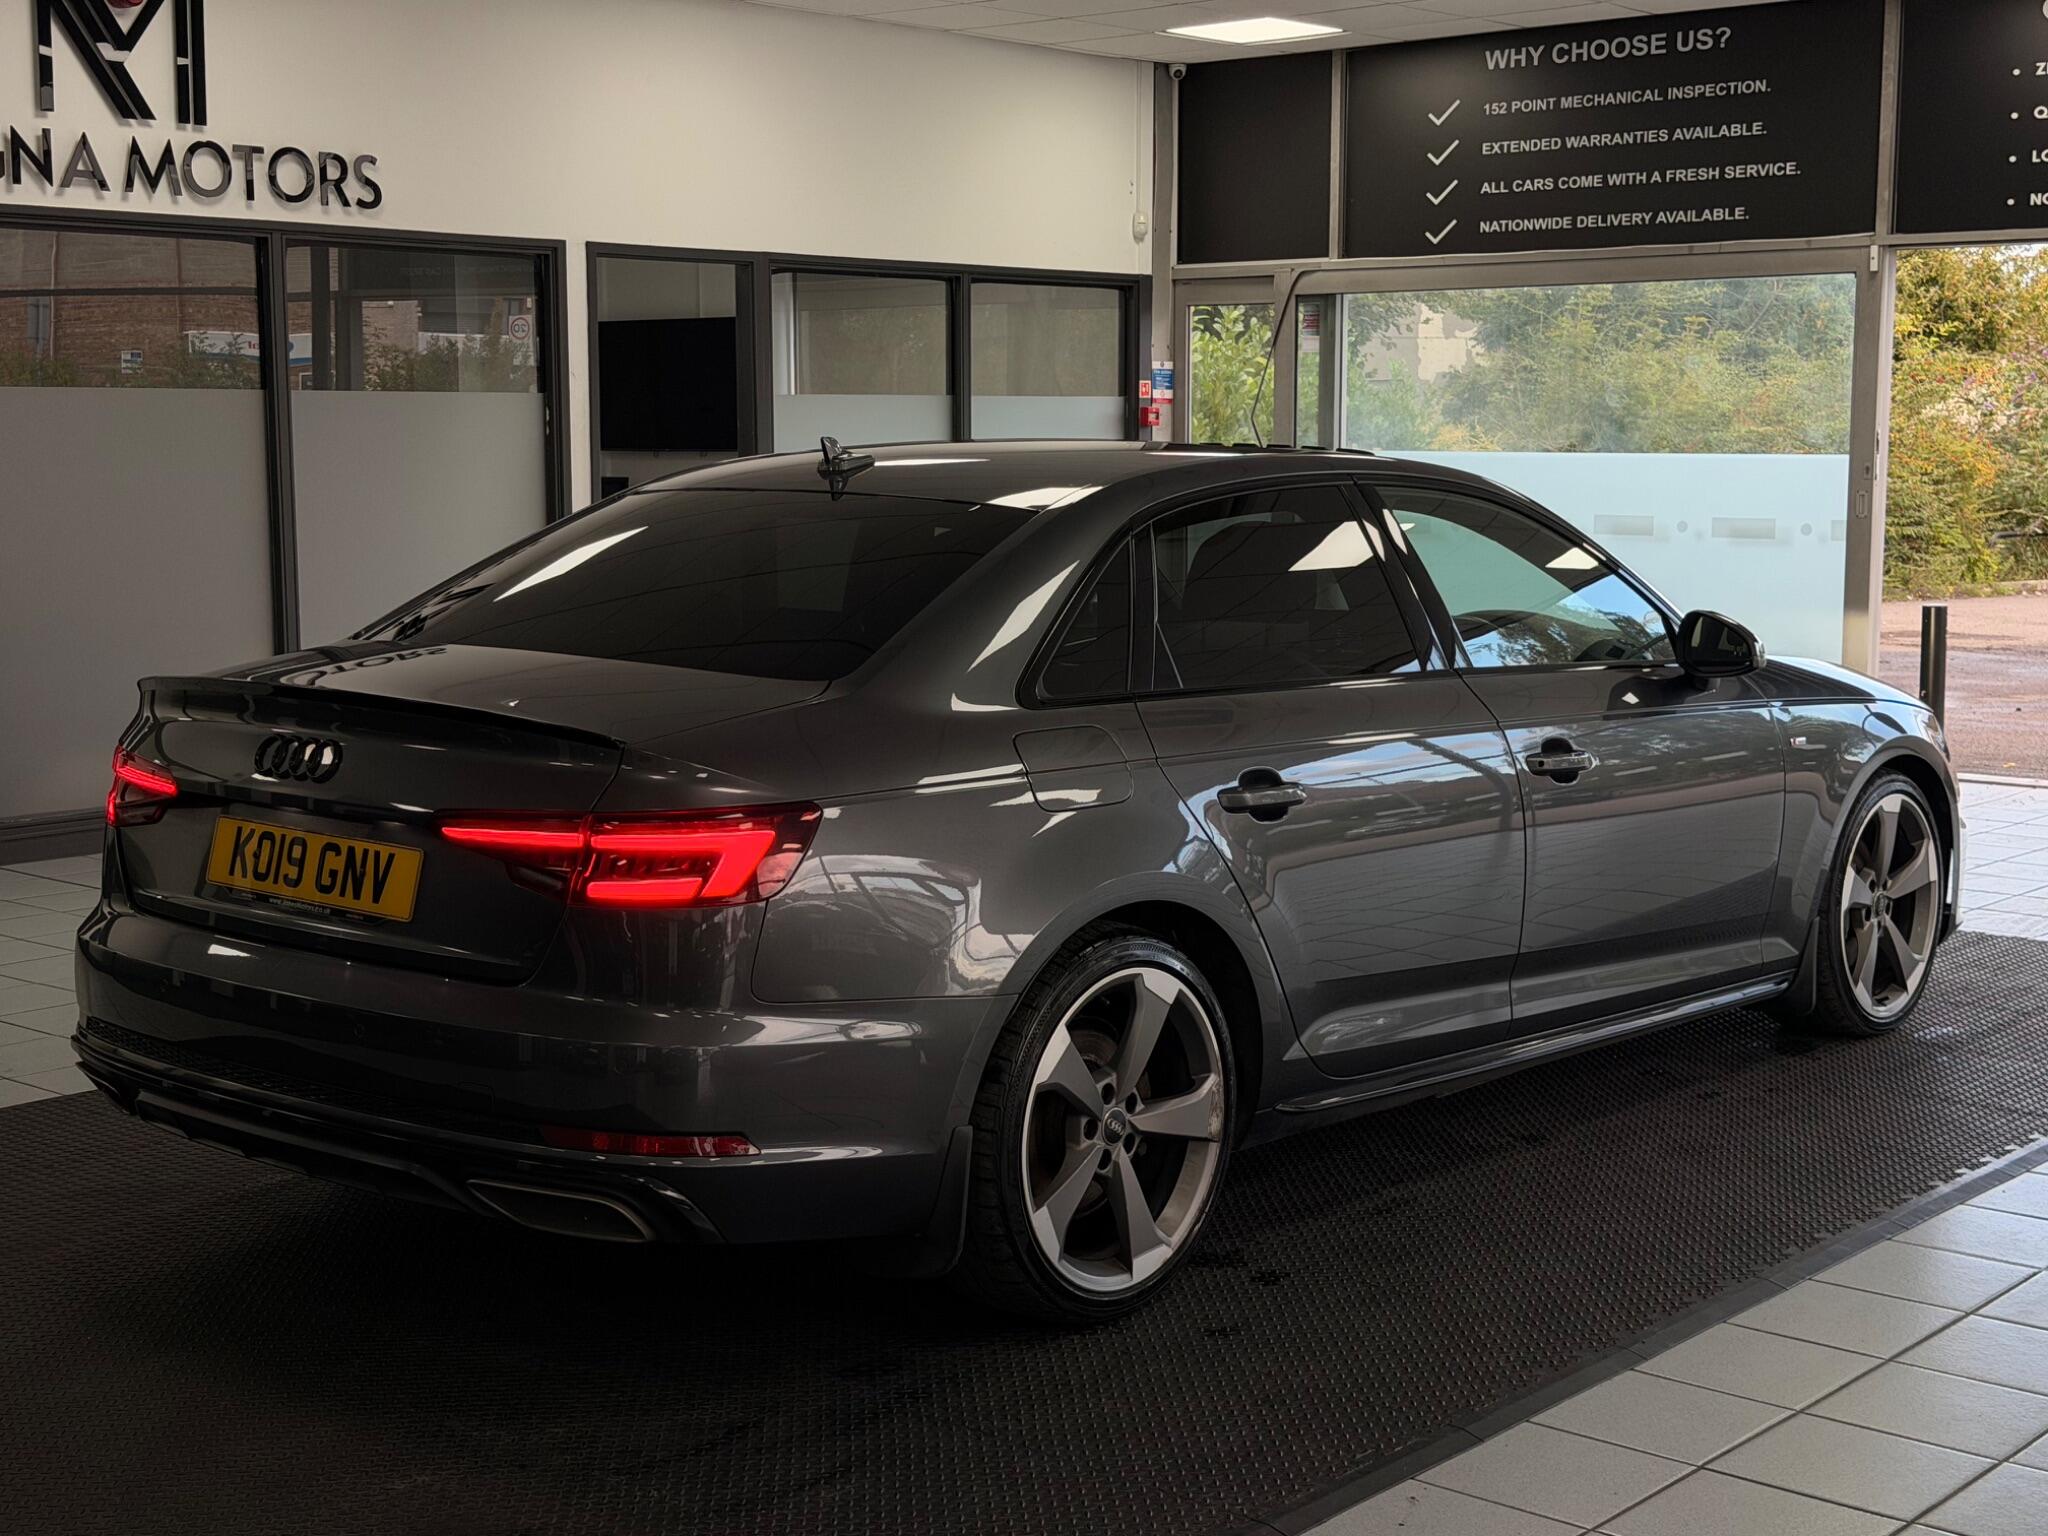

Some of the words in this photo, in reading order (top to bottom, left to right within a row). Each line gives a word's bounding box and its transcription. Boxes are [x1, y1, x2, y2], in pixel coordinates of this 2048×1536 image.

[1486, 46, 1544, 70] WHY
[1552, 33, 1666, 63] CHOOSE
[1677, 27, 1731, 51] US?
[1484, 102, 1507, 115] 152
[1512, 98, 1556, 113] POINT
[1561, 89, 1663, 108] MECHANICAL
[1668, 80, 1770, 99] INSPECTION.
[1483, 138, 1561, 154] EXTENDED
[1566, 129, 1668, 148] WARRANTIES
[1672, 122, 1766, 140] AVAILABLE.
[0, 125, 110, 193] NA
[125, 136, 383, 209] MOTORS
[1481, 182, 1508, 193] ALL
[1513, 178, 1553, 192] CARS
[1559, 175, 1602, 189] COME
[1608, 172, 1646, 185] WITH
[1650, 171, 1661, 183] A
[1666, 167, 1719, 182] FRESH
[1725, 162, 1800, 178] SERVICE.
[1480, 217, 1572, 232] NATIONWIDE
[1577, 212, 1652, 227] DELIVERY
[1656, 207, 1748, 223] AVAILABLE.
[229, 826, 308, 888] KO19
[315, 842, 396, 904] GNV
